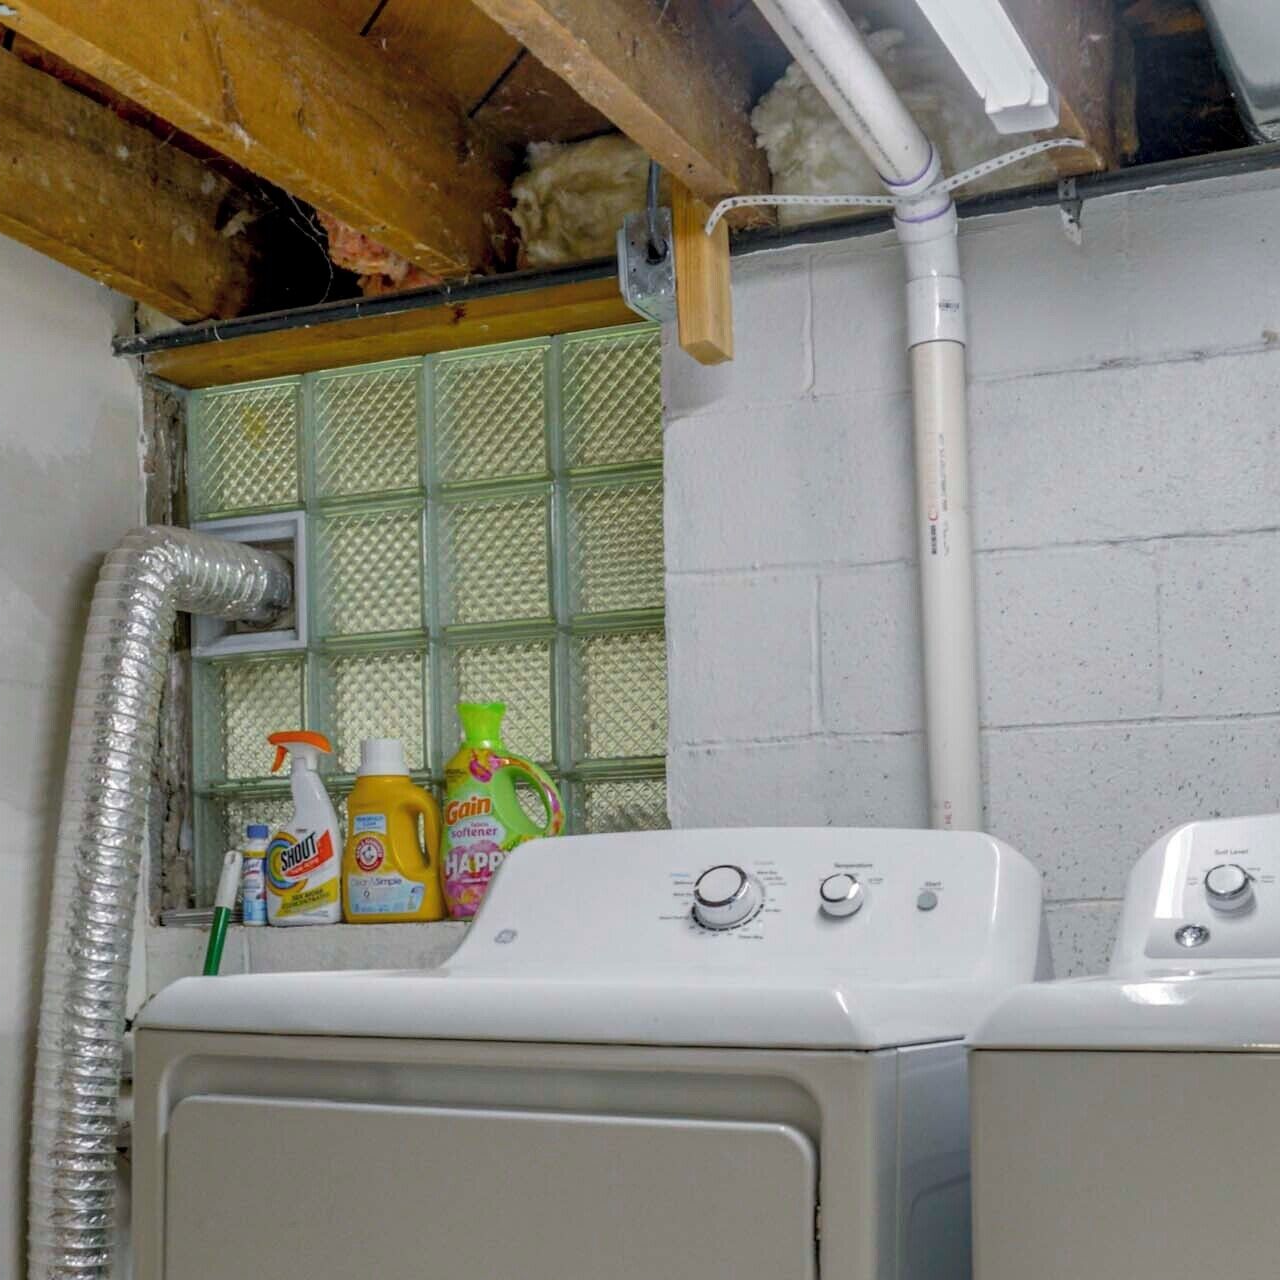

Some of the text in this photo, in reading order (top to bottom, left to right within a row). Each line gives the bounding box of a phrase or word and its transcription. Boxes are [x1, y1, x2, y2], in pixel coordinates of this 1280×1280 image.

[445, 795, 491, 825] Gain
[451, 826, 498, 839] softener
[280, 831, 317, 872] SHOUT
[445, 851, 505, 879] HAPP
